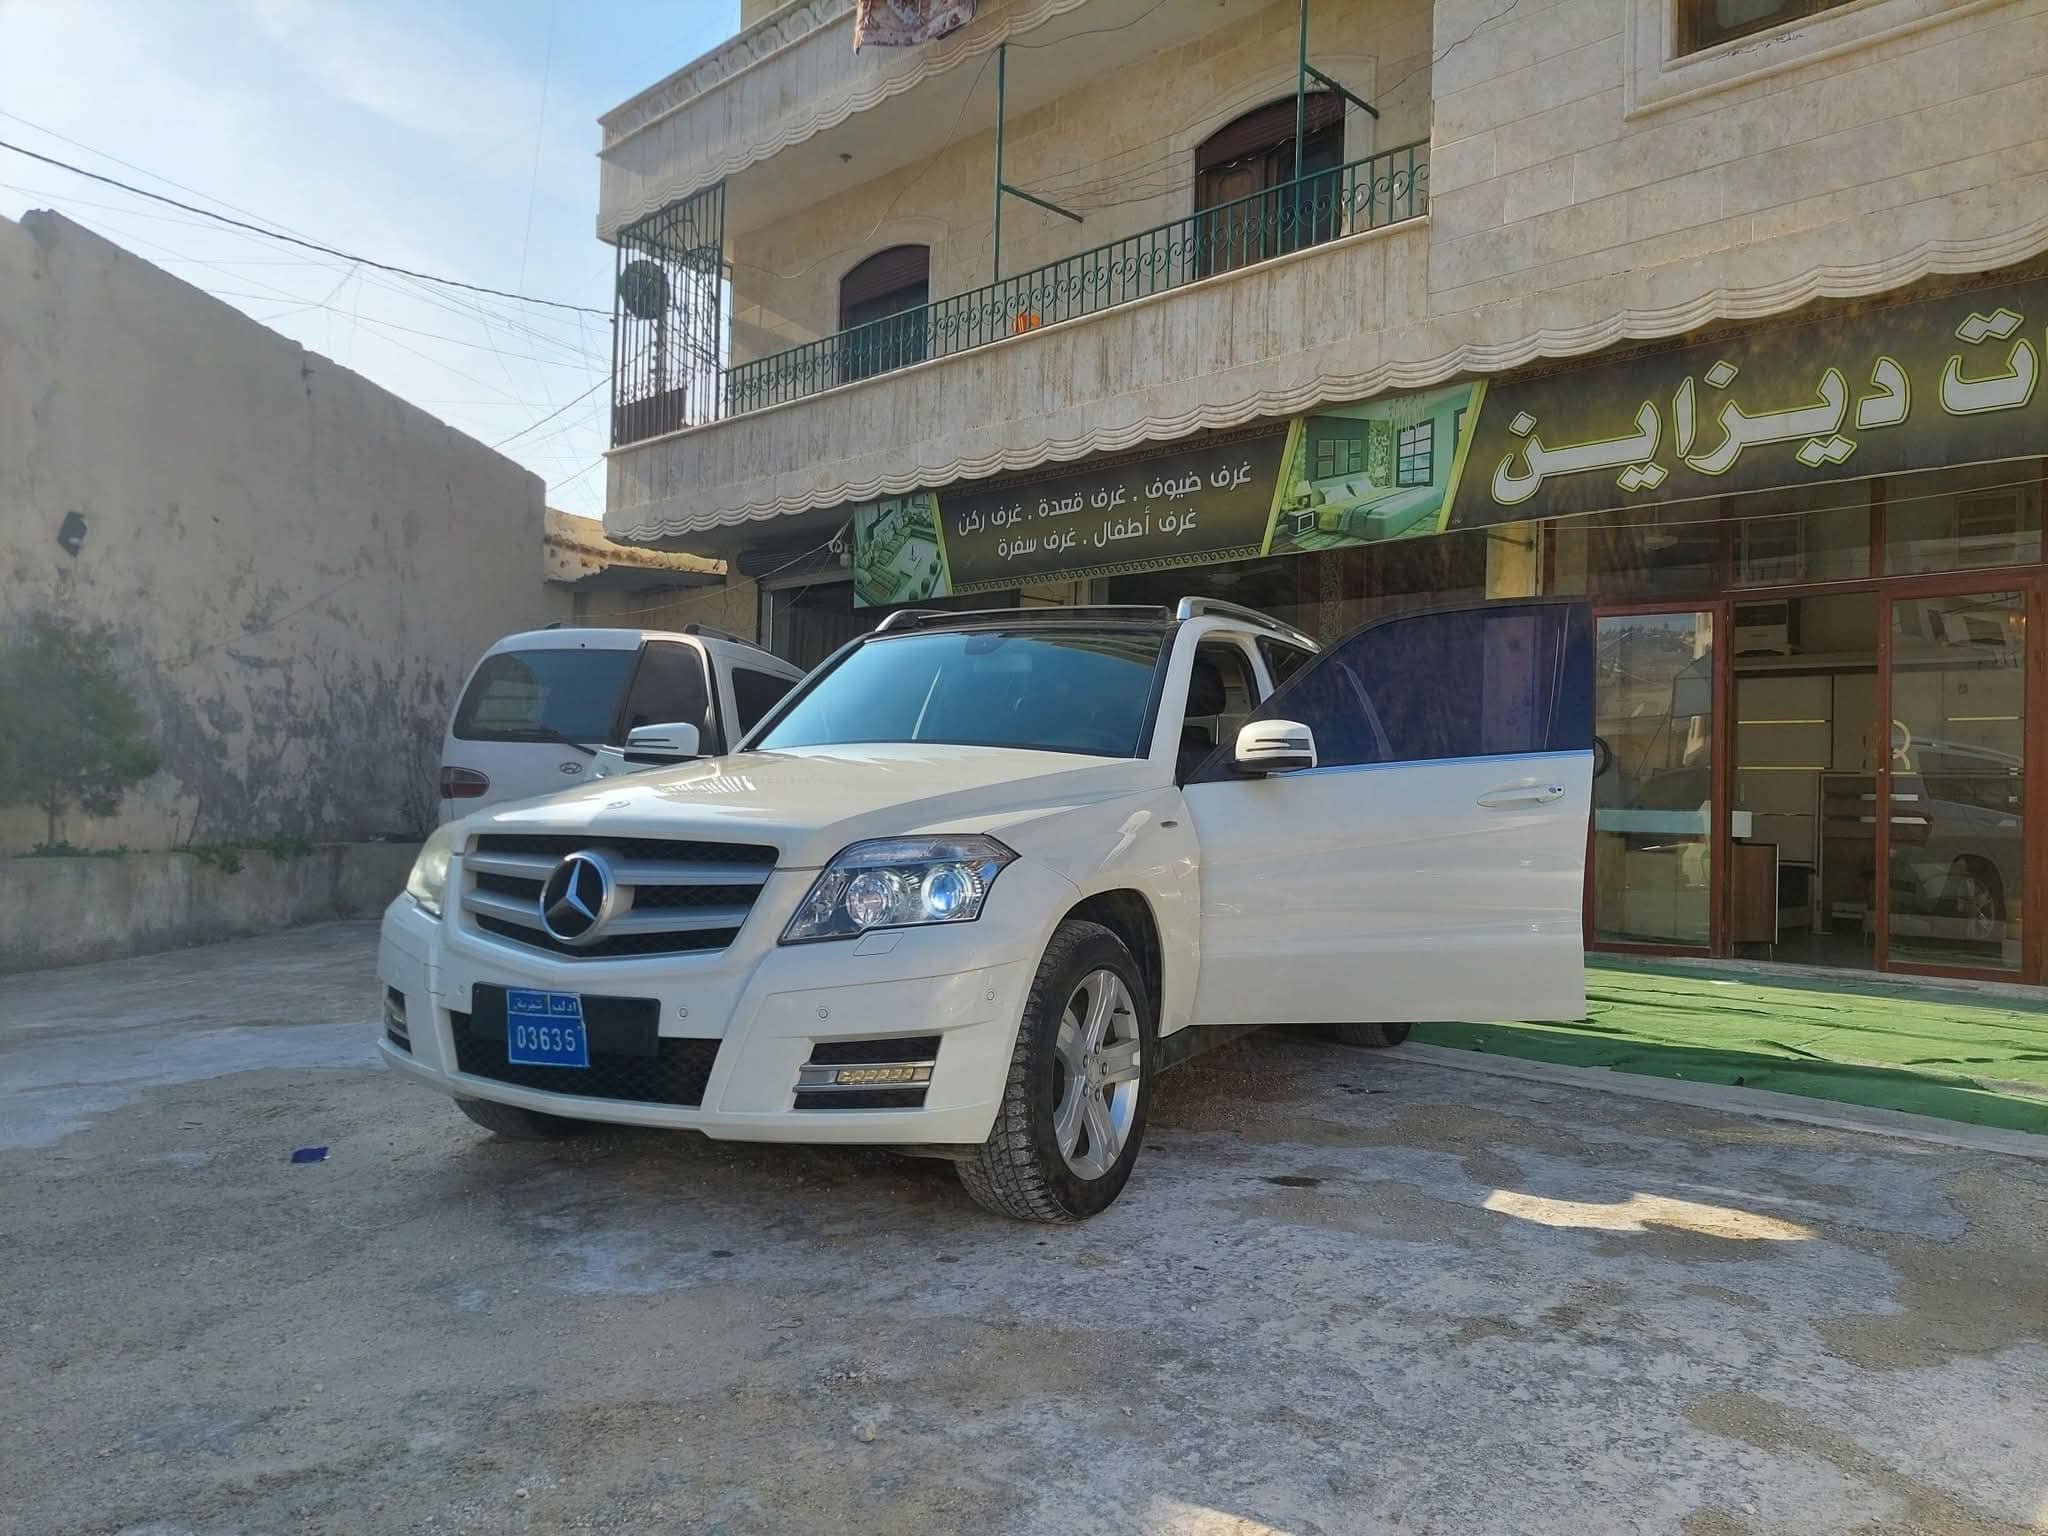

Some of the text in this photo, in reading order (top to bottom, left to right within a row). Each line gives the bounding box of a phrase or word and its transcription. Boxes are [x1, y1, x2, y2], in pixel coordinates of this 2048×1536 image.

[1491, 307, 2048, 504] ت ديزاين
[958, 460, 1251, 536] غرف ضيوف غرف قعدة غرف ركن
[998, 505, 1197, 561] غرف أطفال غرف سفرة
[517, 1025, 576, 1052] 03635
